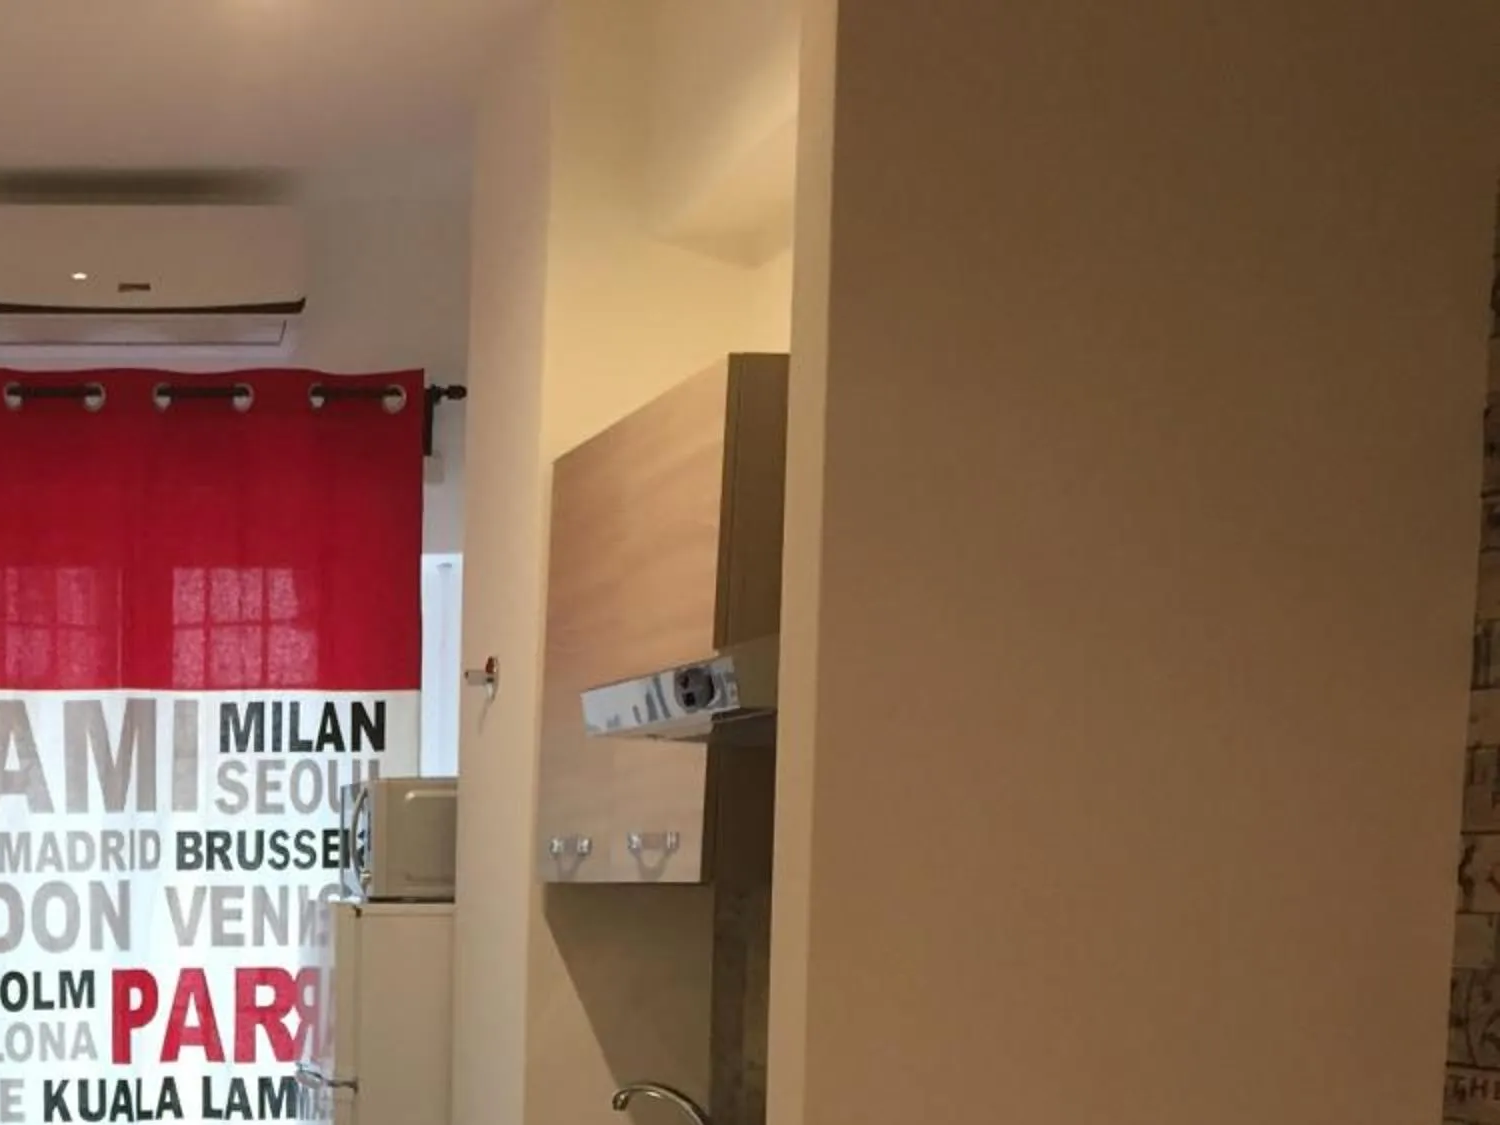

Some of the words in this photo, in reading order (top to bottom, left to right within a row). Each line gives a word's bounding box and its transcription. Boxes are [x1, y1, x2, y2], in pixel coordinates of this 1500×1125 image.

[219, 701, 387, 754] MILAN
[176, 829, 345, 873] BRUSSE
[43, 1076, 185, 1124] KUALA
